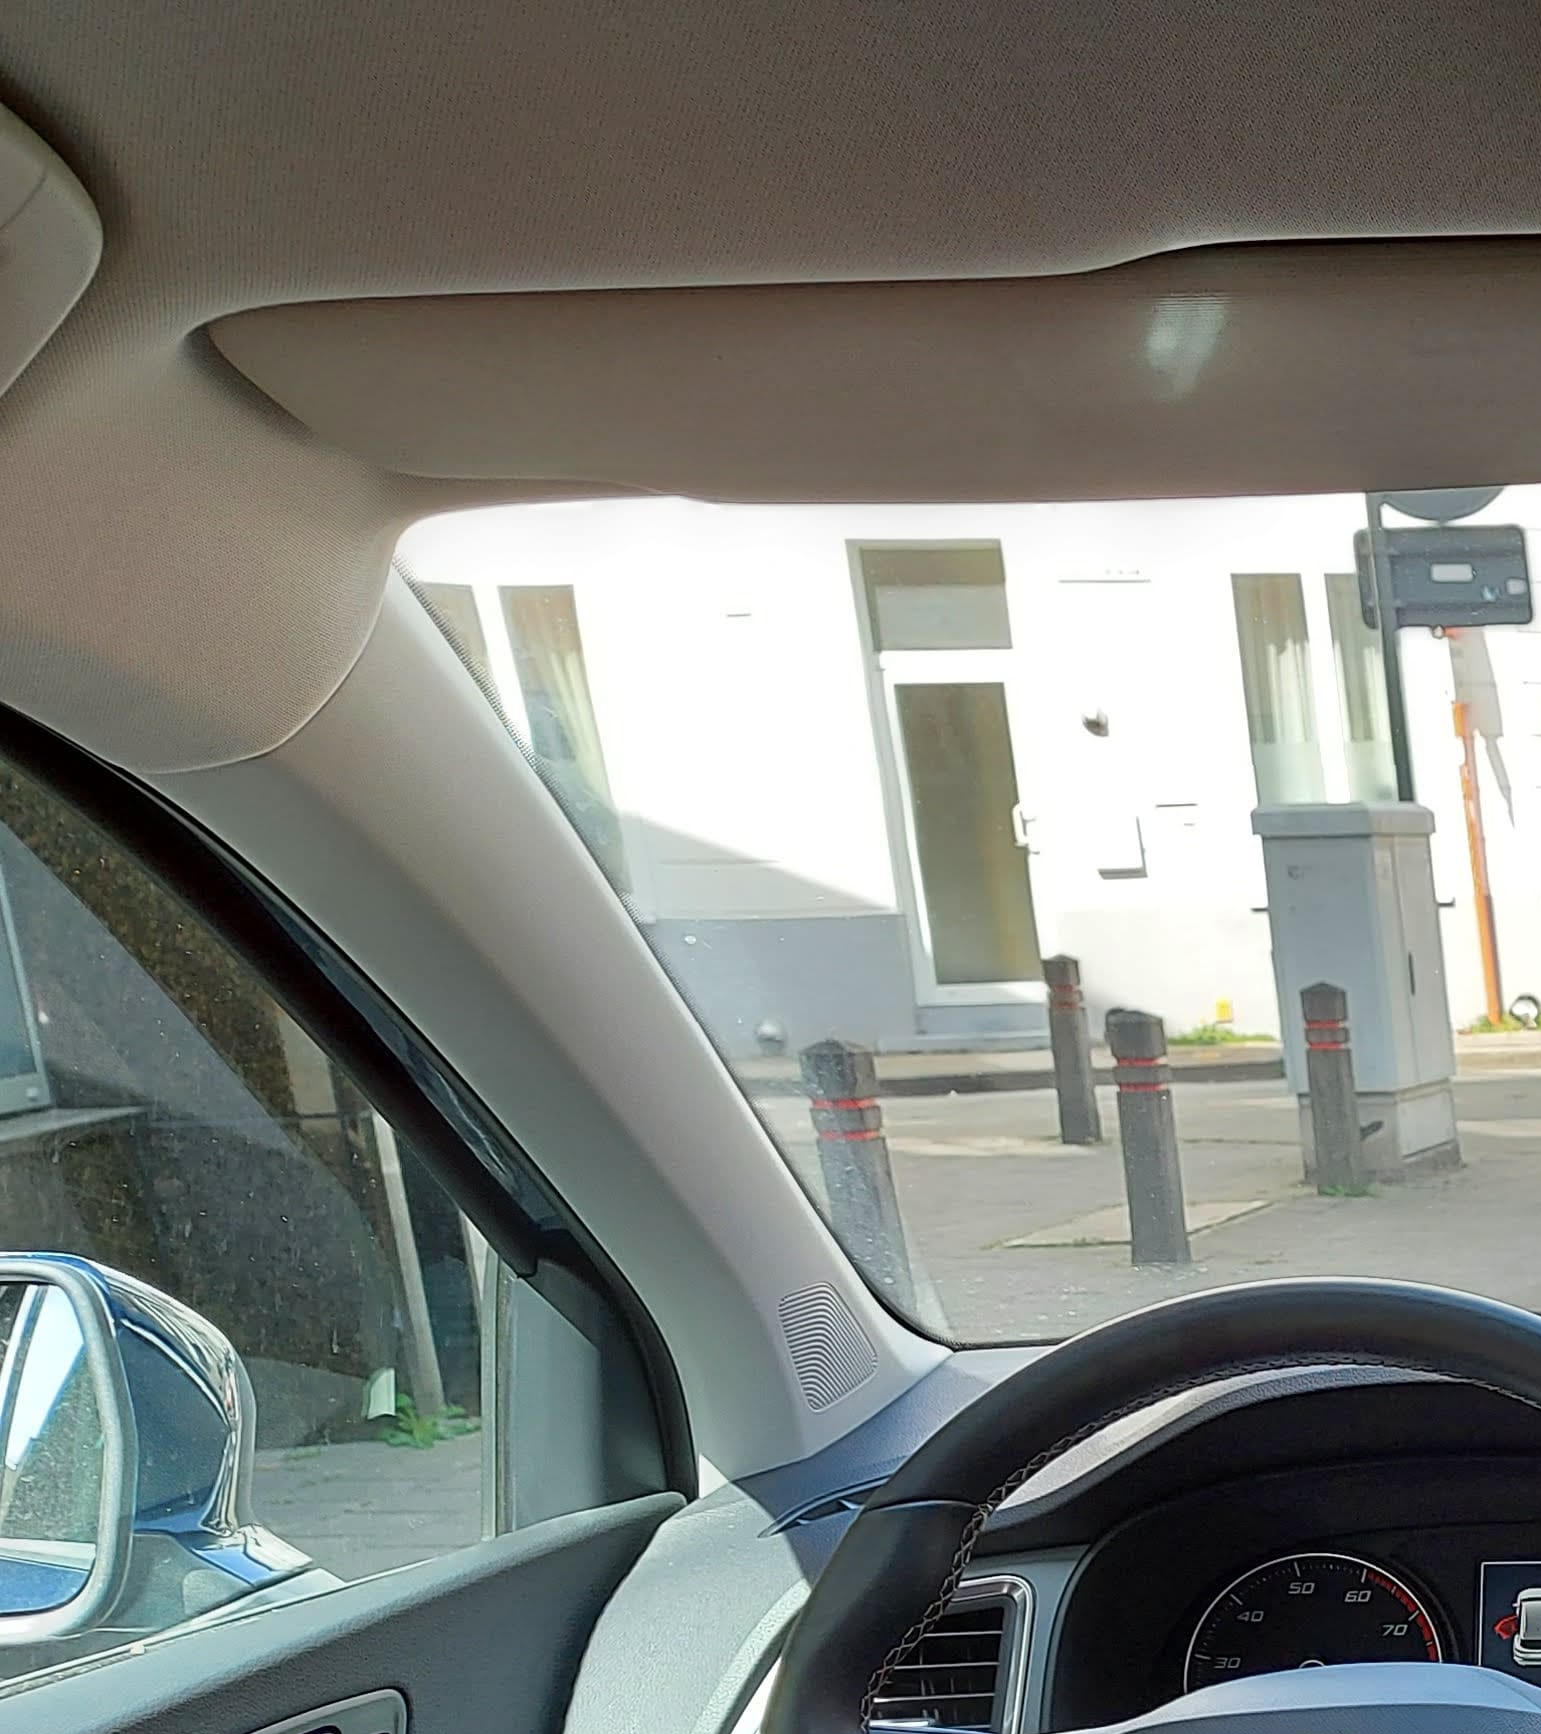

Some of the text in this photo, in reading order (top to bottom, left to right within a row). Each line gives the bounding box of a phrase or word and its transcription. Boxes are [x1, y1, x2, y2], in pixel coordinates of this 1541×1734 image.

[1288, 1582, 1316, 1595] 50
[1344, 1590, 1372, 1603] 60
[1237, 1611, 1265, 1623] 40
[1382, 1624, 1409, 1637] 70
[1214, 1657, 1242, 1669] 30
